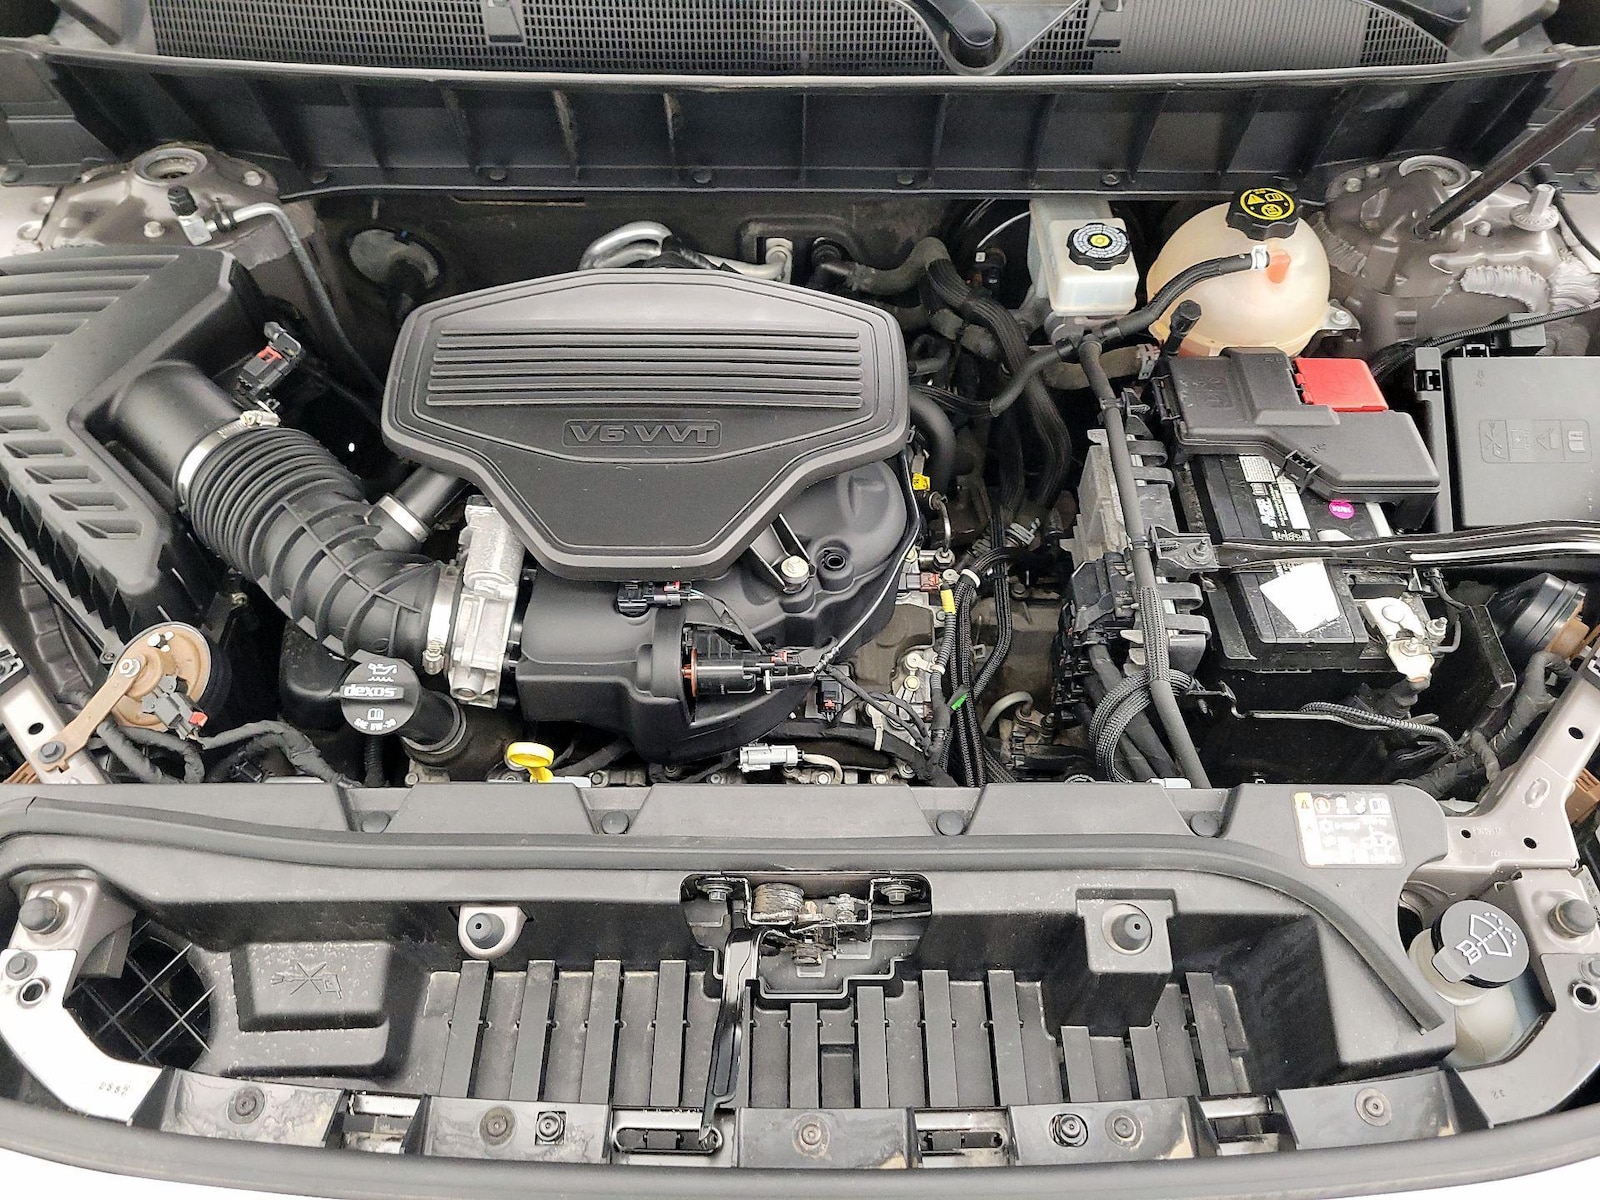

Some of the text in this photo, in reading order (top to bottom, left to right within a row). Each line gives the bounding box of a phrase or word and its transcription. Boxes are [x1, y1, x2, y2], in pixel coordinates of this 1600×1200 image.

[570, 425, 717, 443] V6 VVT
[344, 684, 398, 697] dexos
